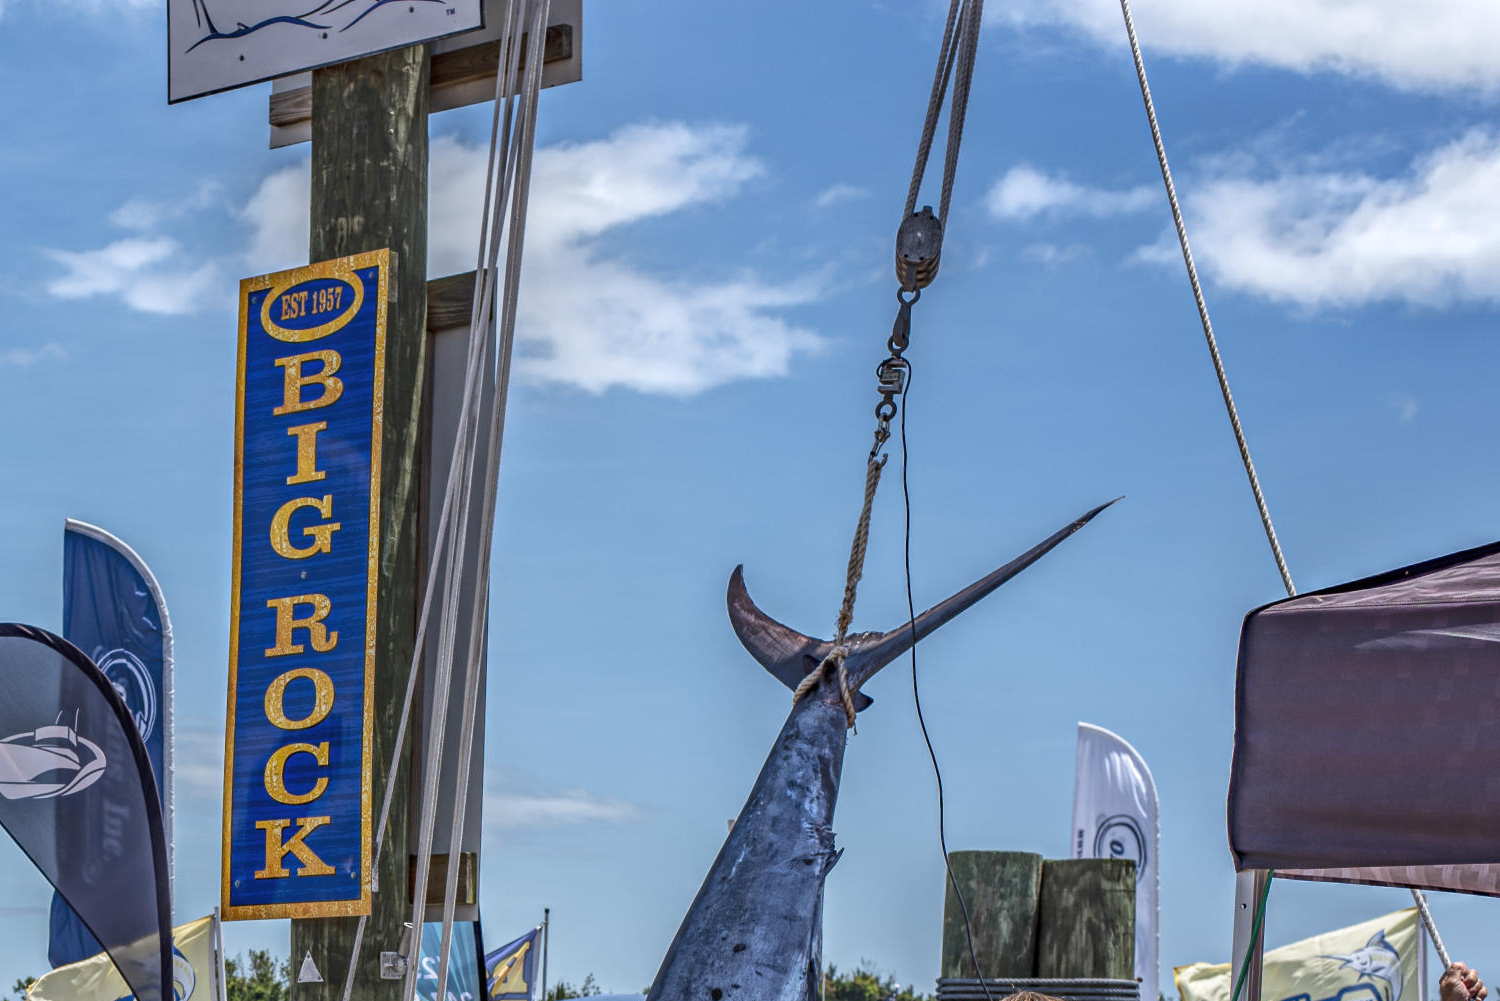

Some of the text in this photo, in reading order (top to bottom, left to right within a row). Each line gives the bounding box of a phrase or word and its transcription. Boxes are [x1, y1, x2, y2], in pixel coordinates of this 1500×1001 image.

[280, 287, 343, 320] EST 1957
[270, 349, 344, 561] BIG
[254, 594, 339, 879] ROCK
